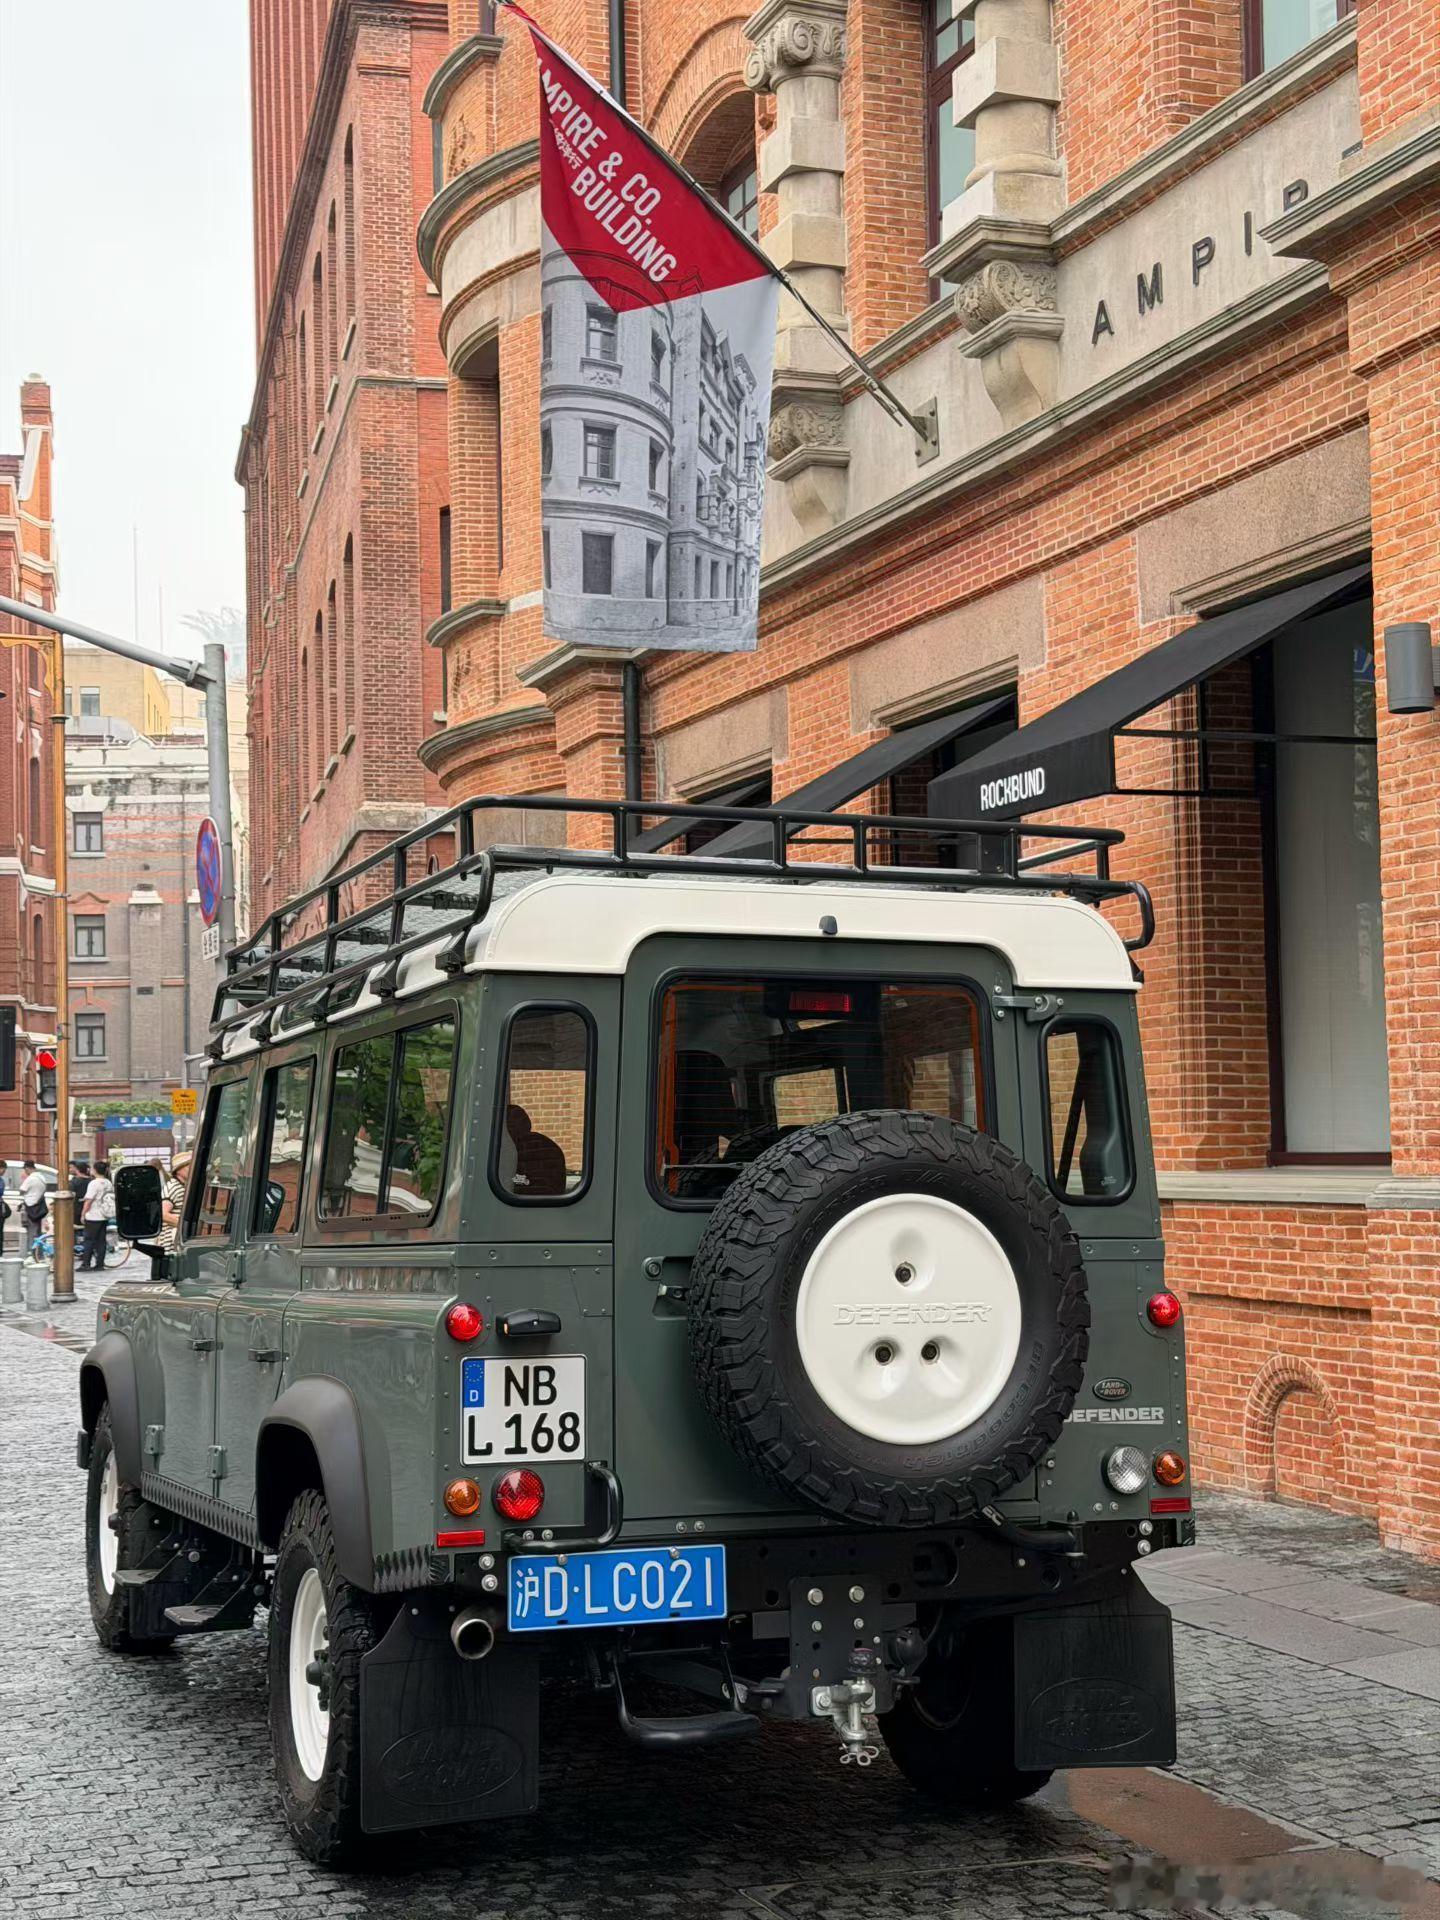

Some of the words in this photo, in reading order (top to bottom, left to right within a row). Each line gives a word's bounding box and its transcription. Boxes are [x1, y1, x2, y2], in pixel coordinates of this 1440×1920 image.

[537, 58, 607, 159] MPIRE
[598, 152, 623, 182] &
[570, 166, 677, 283] BUILDING
[1092, 141, 1364, 346] AMPI
[980, 767, 1045, 811] ROCKBUND
[832, 1302, 993, 1326] DEFENDER
[469, 1390, 479, 1402] D
[504, 1365, 557, 1406] NB
[504, 1412, 581, 1455] 168
